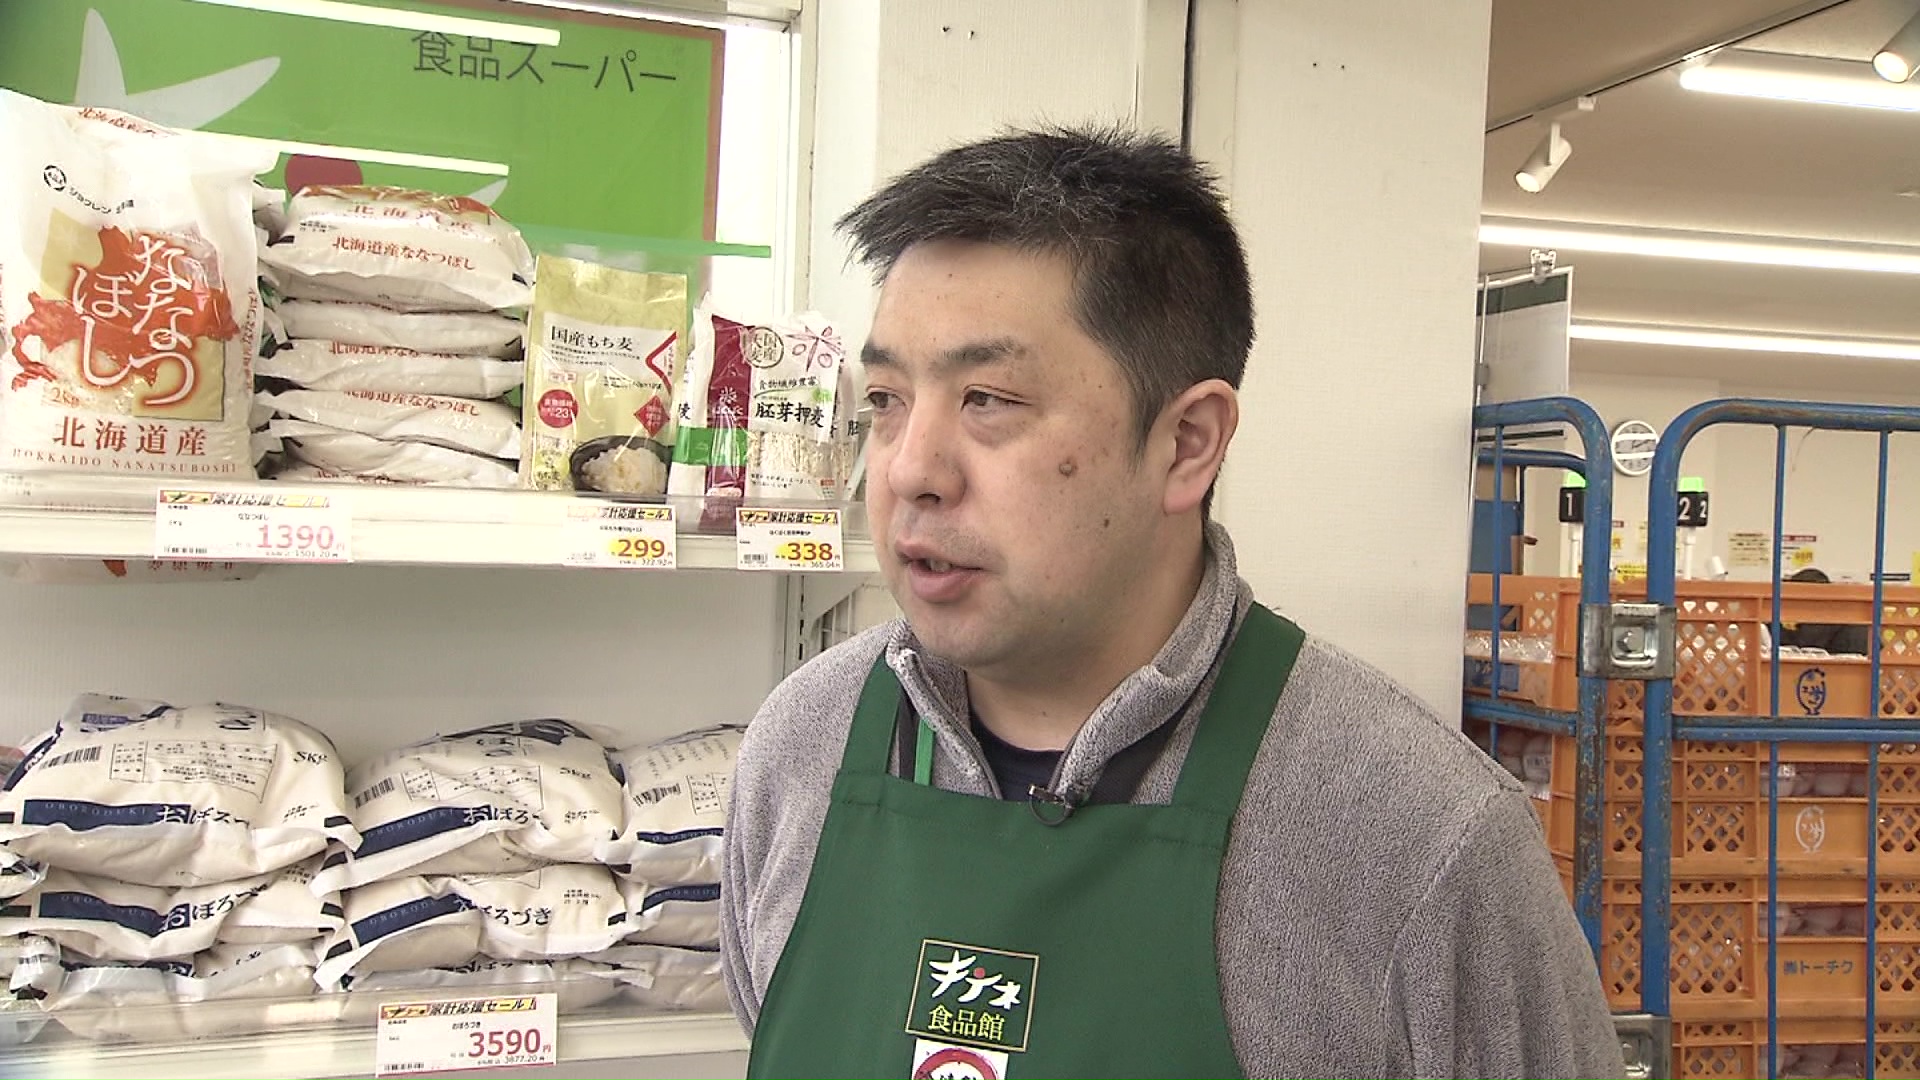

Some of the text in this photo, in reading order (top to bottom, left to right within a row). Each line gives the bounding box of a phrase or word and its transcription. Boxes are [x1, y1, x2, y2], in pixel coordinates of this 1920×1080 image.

[411, 30, 677, 92] 食品スーパー
[331, 236, 476, 270] 北海道産ななつぼし
[551, 325, 633, 352] 国産もち麦
[755, 402, 825, 428] 胚芽押麦
[53, 416, 207, 457] 北海道産
[13, 448, 237, 474] HOKKAIDO NANATSUBOSHI
[1566, 493, 1573, 516] 1
[1679, 497, 1690, 520] 2
[256, 524, 334, 550] 1390
[618, 540, 665, 558] 299
[788, 543, 833, 560] 338
[928, 1004, 1005, 1041] 食品館
[468, 1028, 541, 1058] 3590
